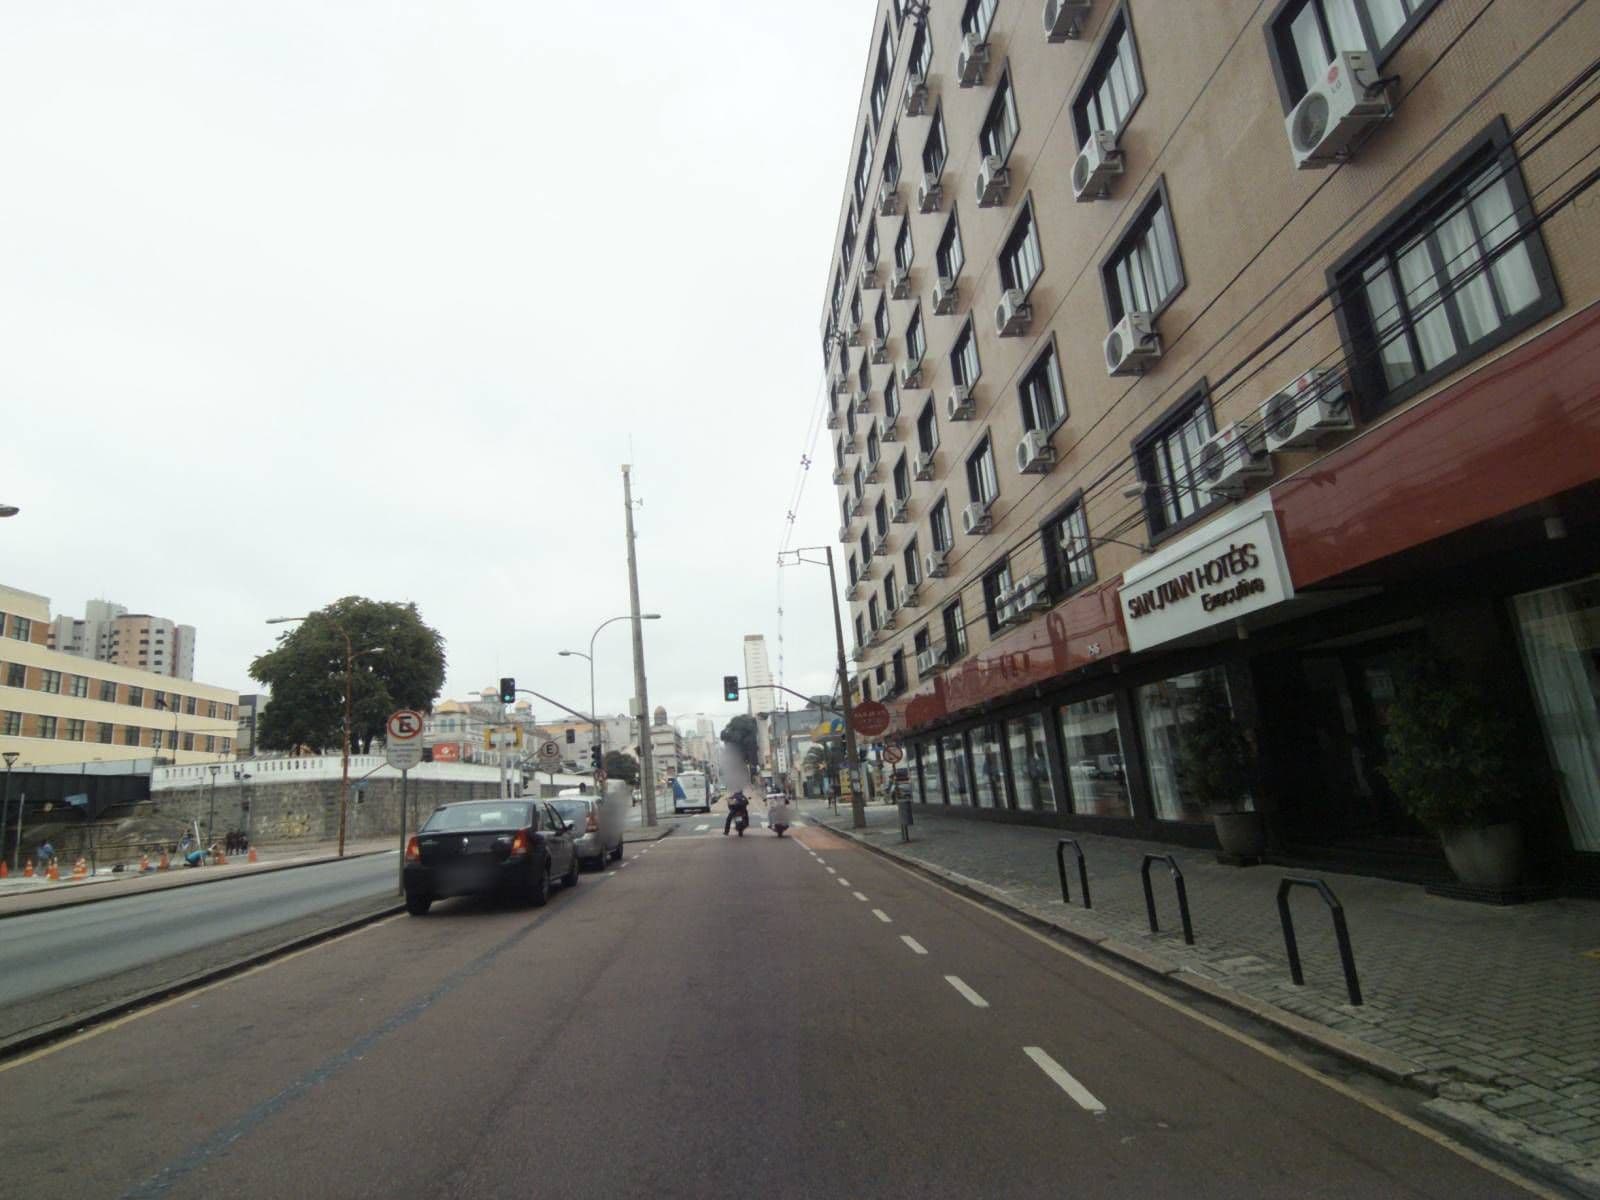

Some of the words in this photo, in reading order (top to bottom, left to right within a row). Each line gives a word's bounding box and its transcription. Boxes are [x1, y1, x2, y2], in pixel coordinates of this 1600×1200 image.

[1128, 590, 1156, 619] SAN
[1155, 571, 1196, 610] JUAN
[546, 744, 554, 755] E
